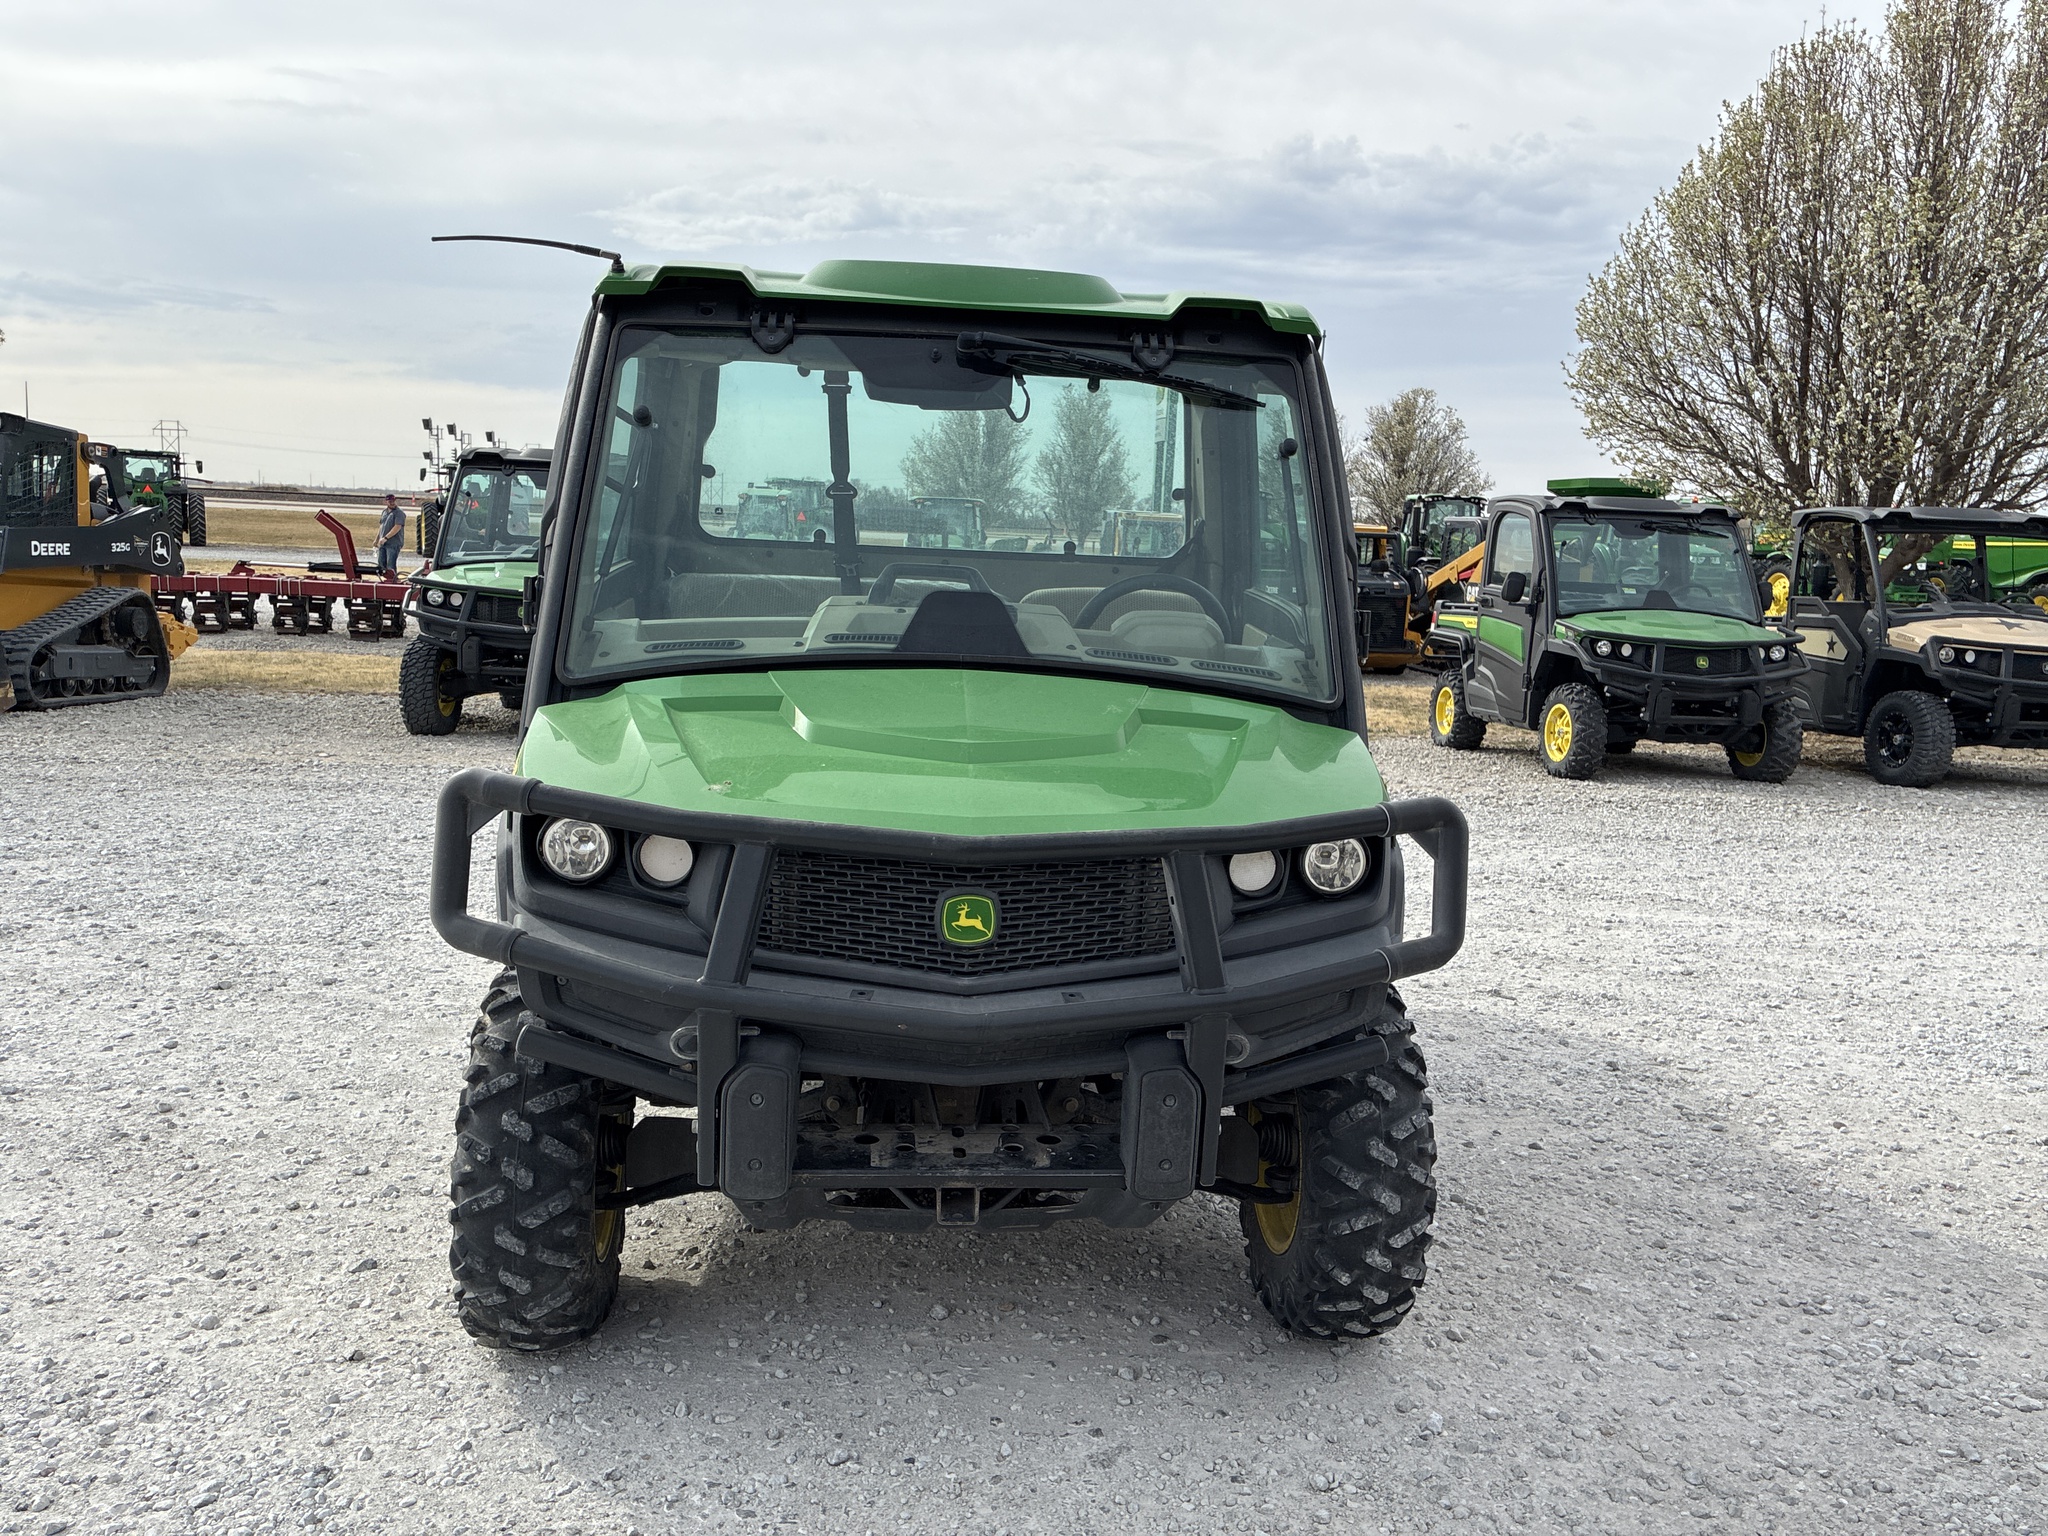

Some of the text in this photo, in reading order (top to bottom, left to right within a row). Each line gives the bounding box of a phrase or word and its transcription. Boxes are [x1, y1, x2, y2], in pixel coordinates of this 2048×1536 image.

[30, 540, 71, 556] DEERE
[111, 542, 131, 552] 325G
[1466, 585, 1480, 602] CAT
